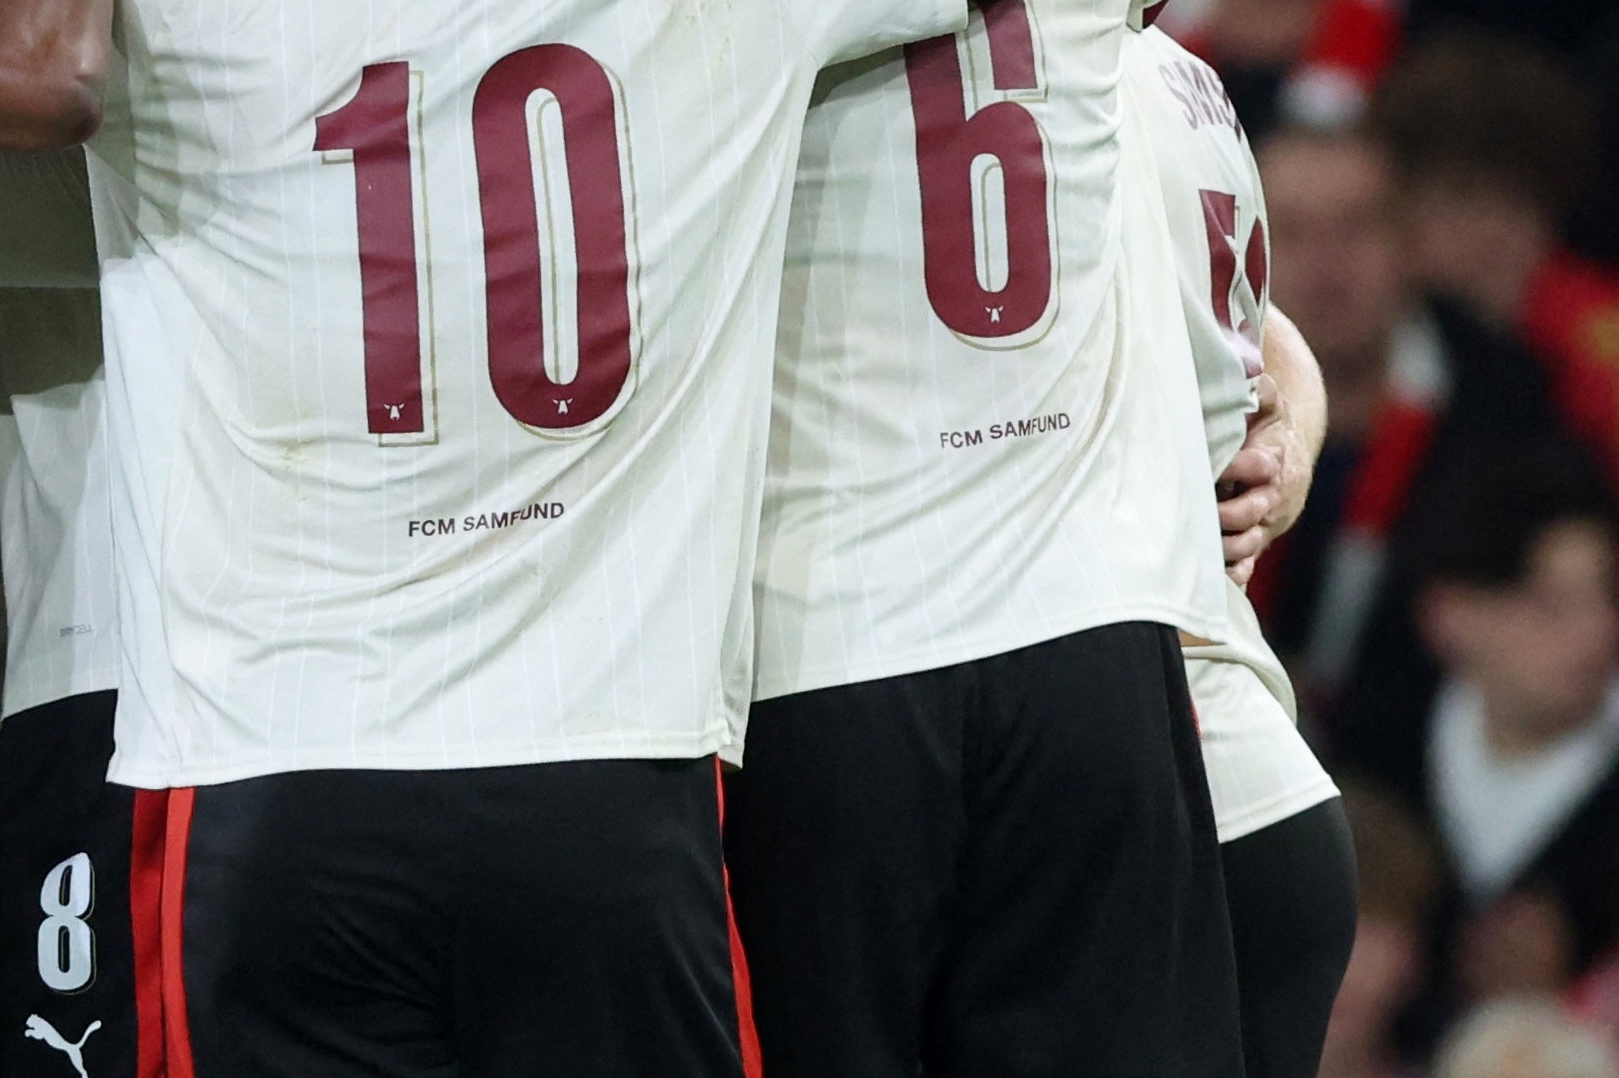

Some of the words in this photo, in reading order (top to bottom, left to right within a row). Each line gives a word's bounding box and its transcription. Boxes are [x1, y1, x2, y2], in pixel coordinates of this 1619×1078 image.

[312, 42, 637, 440] 10
[940, 429, 984, 449] FCM
[989, 412, 1071, 440] SAMFUND
[408, 517, 456, 538] FCM
[463, 502, 565, 532] SAMFUND
[37, 852, 96, 993] 8
